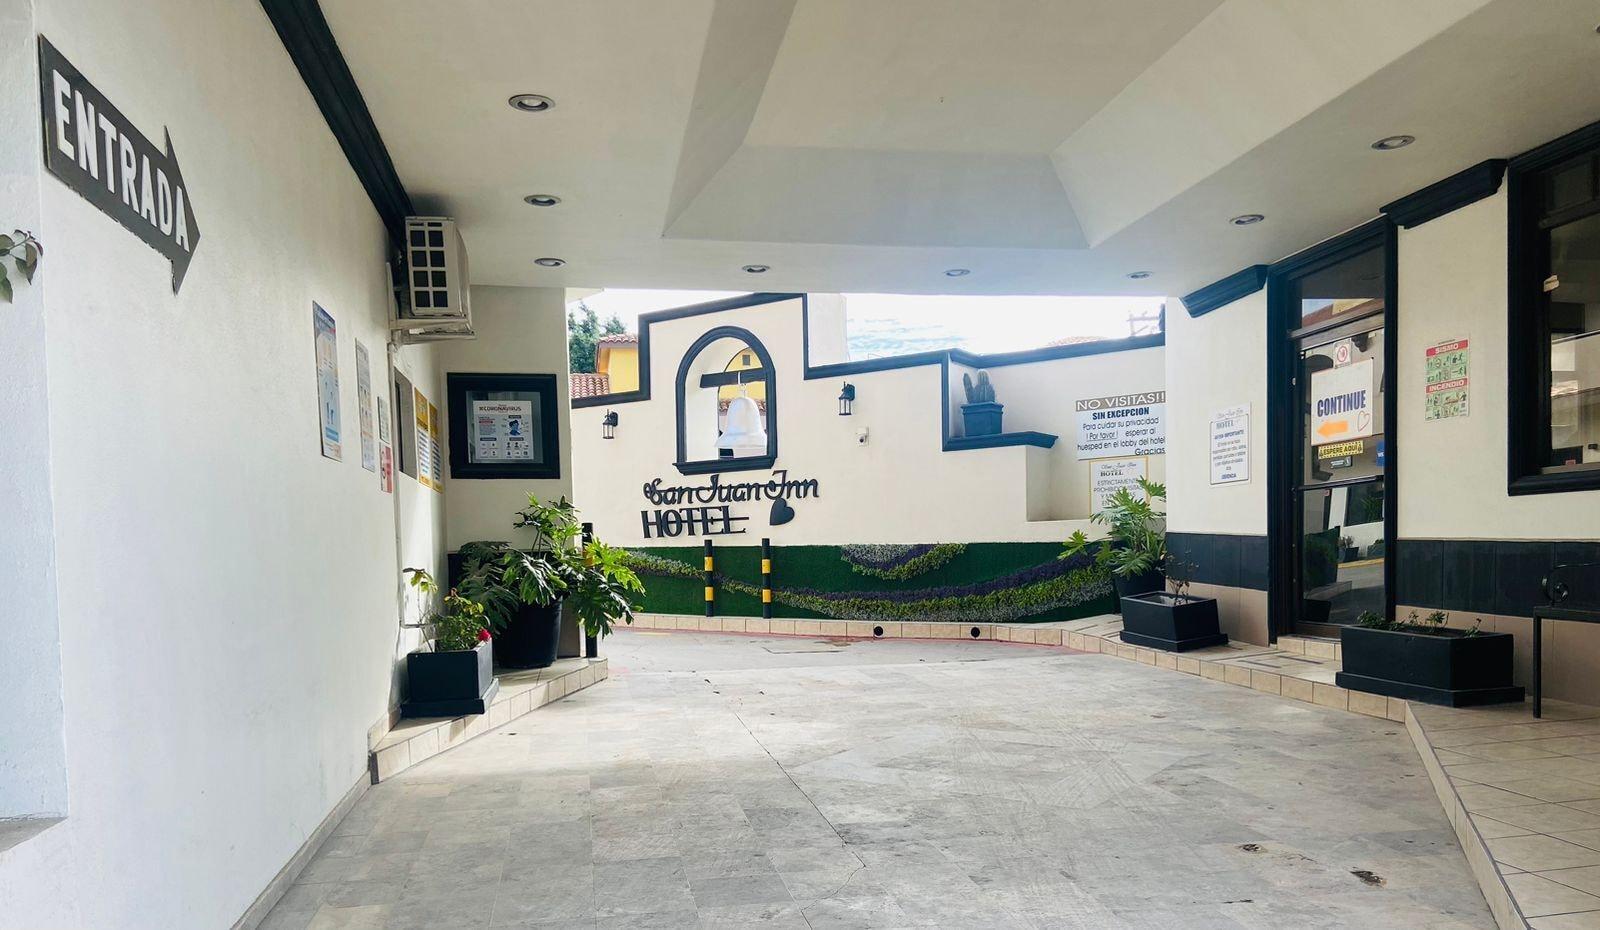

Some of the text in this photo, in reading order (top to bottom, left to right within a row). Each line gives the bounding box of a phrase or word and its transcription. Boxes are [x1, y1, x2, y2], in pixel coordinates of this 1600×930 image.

[53, 69, 190, 252] ENTRADA
[1435, 343, 1459, 354] SISMO
[1429, 380, 1465, 392] INCENDIO
[1077, 391, 1165, 411] NO VISITAS!!
[1317, 389, 1367, 418] CONTINUE
[1092, 406, 1150, 420] SIN EXCEPCION
[1082, 423, 1096, 431] Para
[1097, 420, 1117, 430] cuidar
[1126, 416, 1160, 428] privacidad
[1090, 432, 1099, 440] Por
[1100, 431, 1115, 439] favor
[1125, 428, 1149, 438] esperar
[1149, 427, 1156, 435] al
[1077, 442, 1103, 451] huesped
[1104, 441, 1112, 449] en
[1120, 439, 1138, 448] lobby
[1138, 437, 1149, 446] del
[1150, 435, 1165, 445] hotel
[1323, 446, 1343, 455] ESPERE
[643, 469, 820, 506] San Juan Inn
[1097, 478, 1139, 487] ESTRICTAMENT
[640, 504, 750, 539] HOTEL
